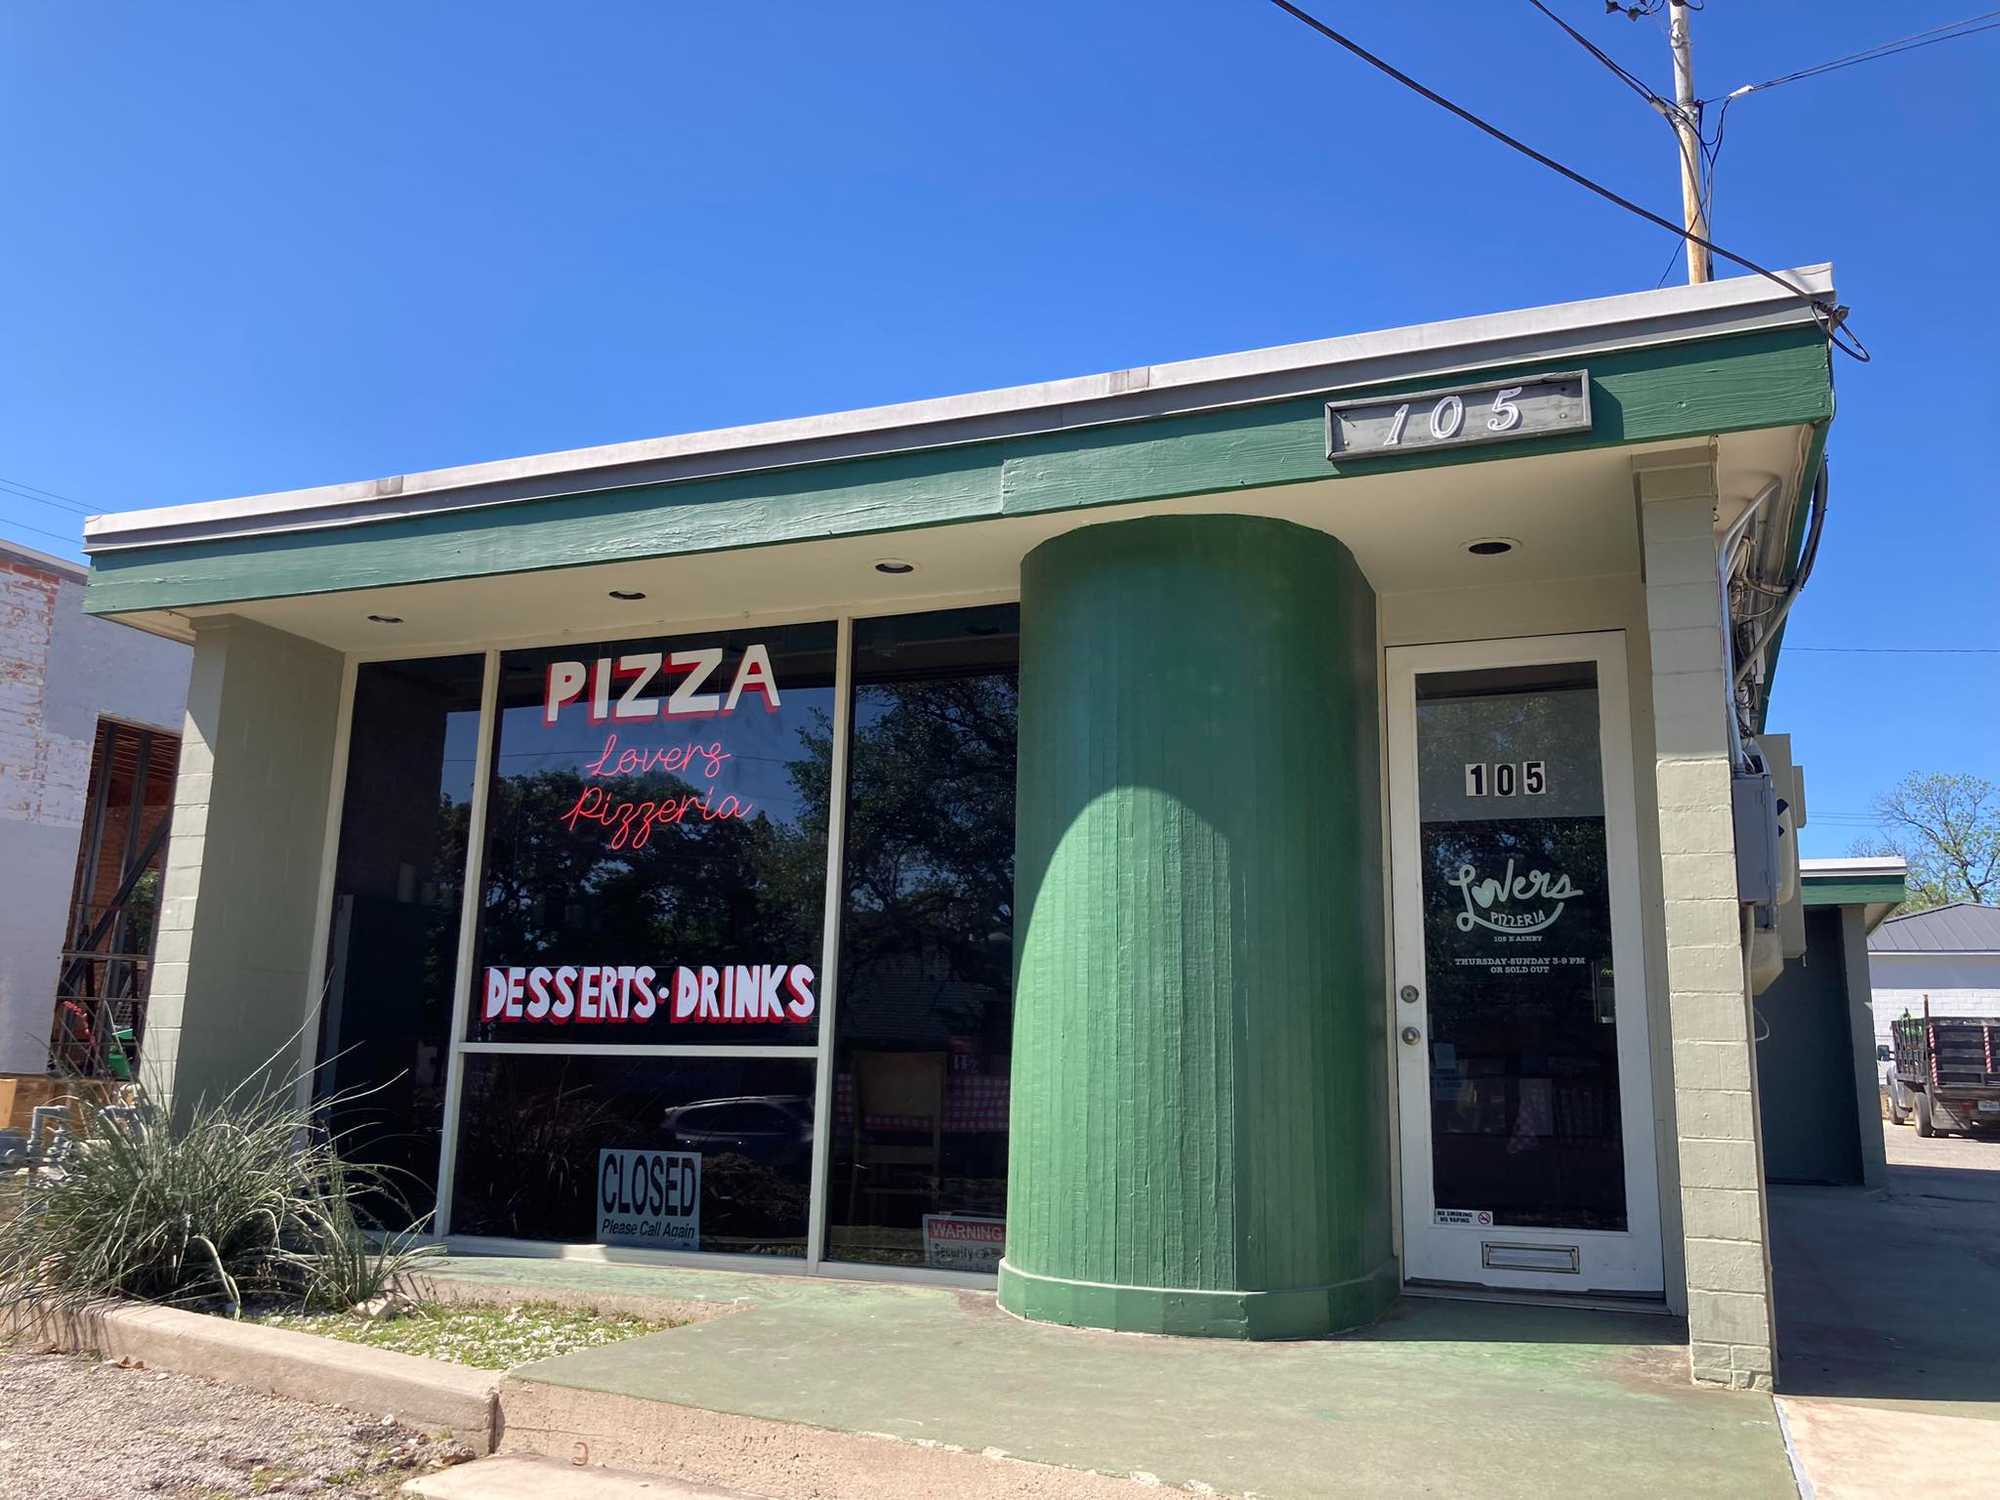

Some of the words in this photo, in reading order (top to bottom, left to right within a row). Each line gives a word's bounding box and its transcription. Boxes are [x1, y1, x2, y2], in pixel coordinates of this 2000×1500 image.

[1384, 386, 1522, 446] 105
[542, 643, 783, 728] PIZZA
[585, 733, 732, 779] Lovers
[1469, 761, 1544, 796] 105
[560, 785, 753, 850] Pizzeria
[1448, 858, 1584, 933] Lovers
[1490, 909, 1546, 927] PIZZERIA
[1569, 957, 1585, 965] PM
[601, 1153, 697, 1217] CLOSED
[601, 1218, 638, 1236] Please
[639, 1220, 661, 1237] Call
[662, 1221, 696, 1241] Again
[931, 1222, 1003, 1241] WARNING
